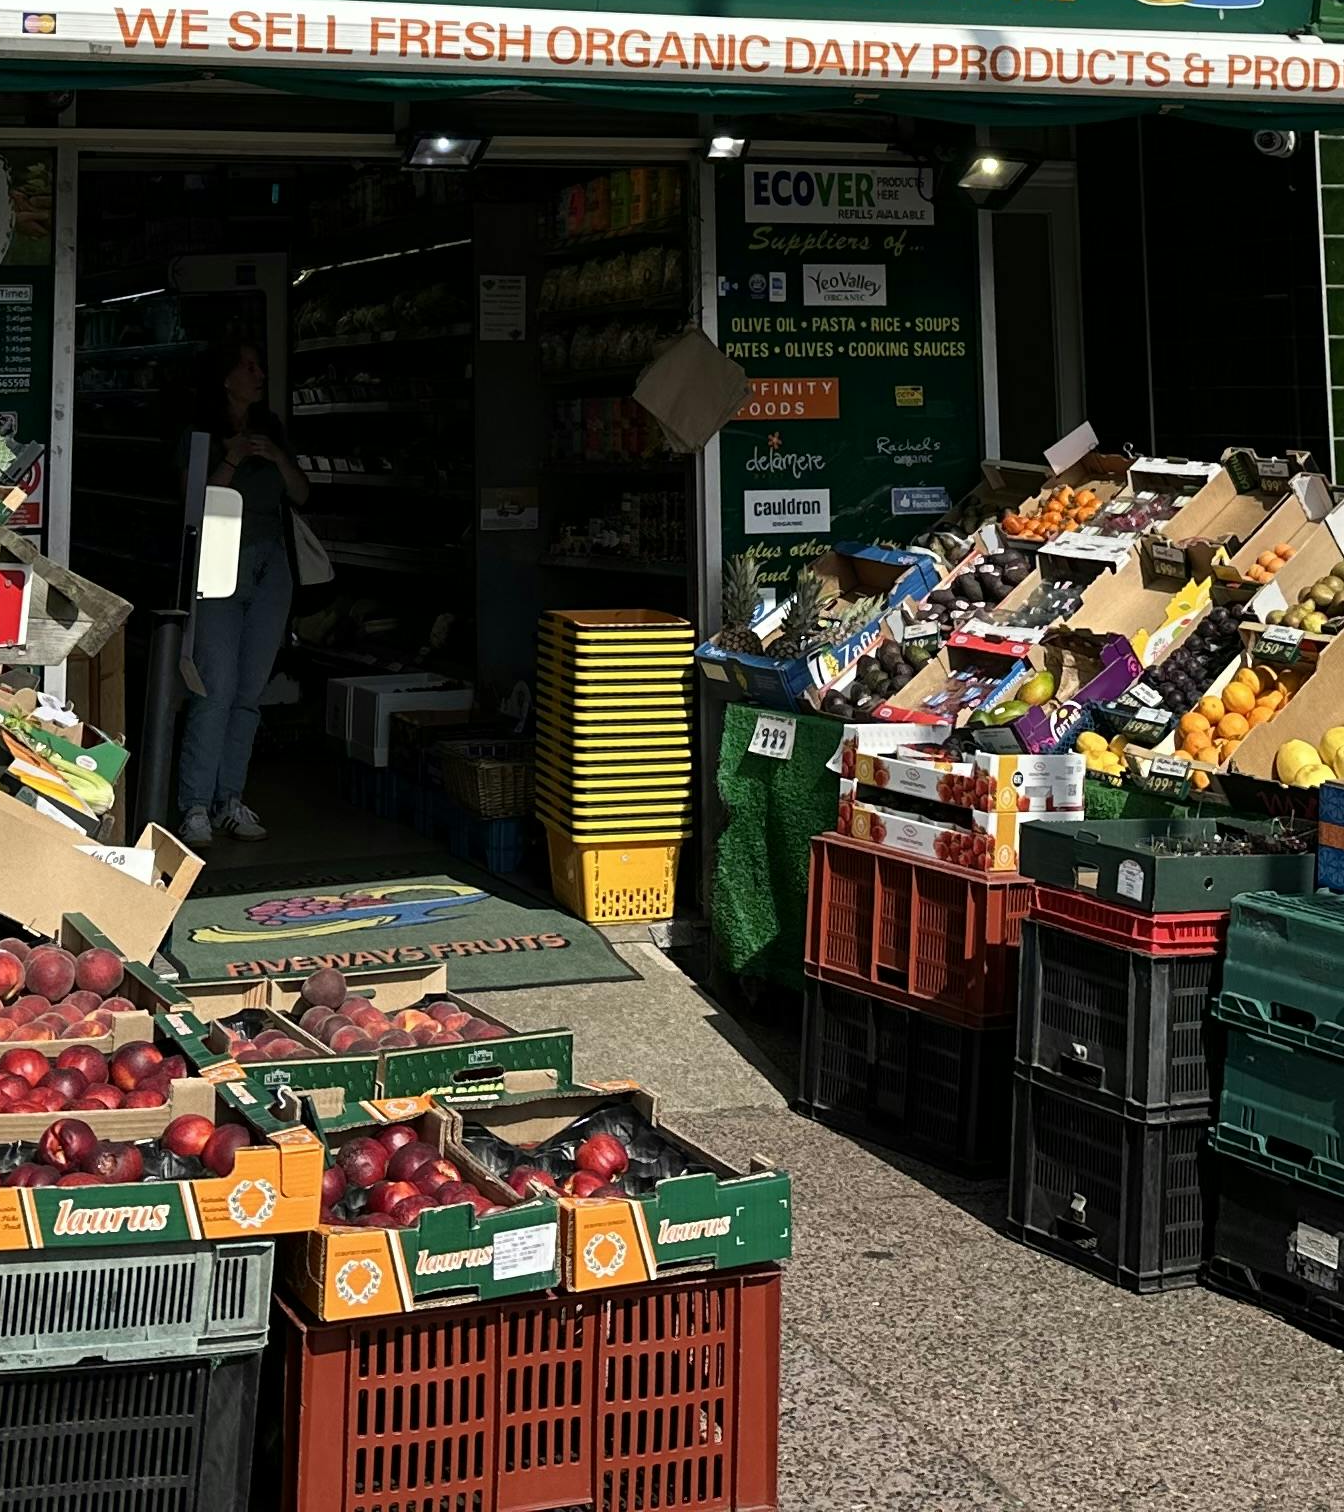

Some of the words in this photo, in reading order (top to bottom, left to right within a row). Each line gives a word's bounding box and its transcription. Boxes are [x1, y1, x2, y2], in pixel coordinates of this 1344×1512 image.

[115, 7, 209, 52] WE
[228, 11, 353, 56] SELL
[370, 17, 532, 63] FRESH
[546, 25, 770, 74] ORGANIC
[784, 36, 917, 80] DAIRY
[936, 43, 1170, 87] PRODUCTS
[1184, 53, 1214, 88] &
[753, 170, 876, 208] ECOVER
[876, 176, 925, 188] PRODUCTS
[876, 189, 900, 200] HERE
[838, 209, 873, 220] REFILLS
[876, 209, 926, 220] AVAILABLE
[748, 225, 872, 255] Suppliers
[0, 289, 29, 298] Times
[731, 317, 772, 333] OLIVE
[776, 317, 798, 333] OIL
[812, 317, 856, 333] PASTA
[870, 317, 902, 333] RICE
[915, 317, 960, 333] SOUPS
[725, 343, 770, 358] PATES
[784, 343, 833, 358] OLIVES
[848, 343, 909, 358] COOKING
[913, 342, 966, 357] SAUCES
[752, 381, 834, 396] FINITY
[876, 437, 941, 455] Rachel's
[746, 446, 826, 479] delamere
[753, 498, 821, 516] cauldron
[755, 565, 791, 583] and
[1055, 718, 1071, 737] EAT
[225, 945, 426, 978] FIVEWAYS
[429, 932, 571, 961] FRUITS
[54, 1198, 171, 1236] laurus
[657, 1215, 731, 1246] laurus
[416, 1244, 494, 1276] laurus
